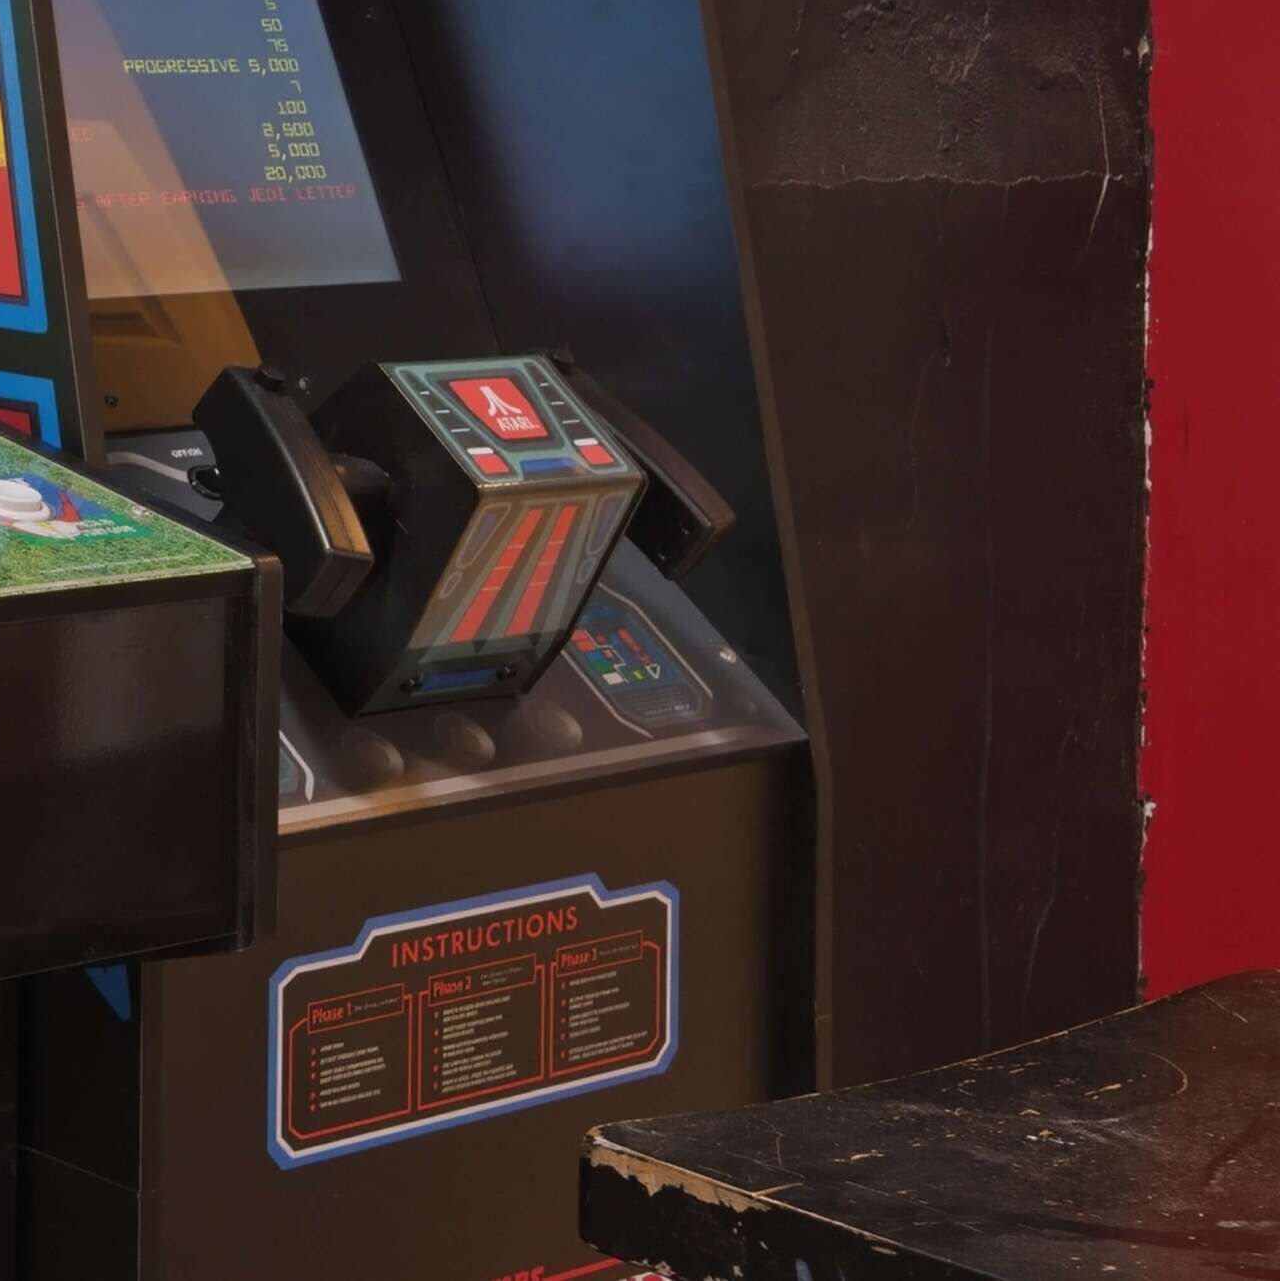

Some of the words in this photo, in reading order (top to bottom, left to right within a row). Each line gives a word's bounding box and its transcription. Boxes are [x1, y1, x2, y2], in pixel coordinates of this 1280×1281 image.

[260, 17, 283, 33] 50
[266, 38, 289, 53] 75
[122, 58, 241, 74] PROGRESSIVE
[248, 58, 300, 76] 5,000
[278, 100, 308, 115] 100
[262, 121, 315, 140] 2,500
[267, 142, 321, 161] 5,000
[263, 164, 327, 184] 20,000
[160, 188, 238, 205] EARNING
[247, 186, 288, 203] JEDI
[296, 184, 357, 201] LETTER
[495, 415, 535, 432] ATARI
[390, 905, 579, 970] INSTRUCTIONS
[311, 1006, 345, 1025] Phase
